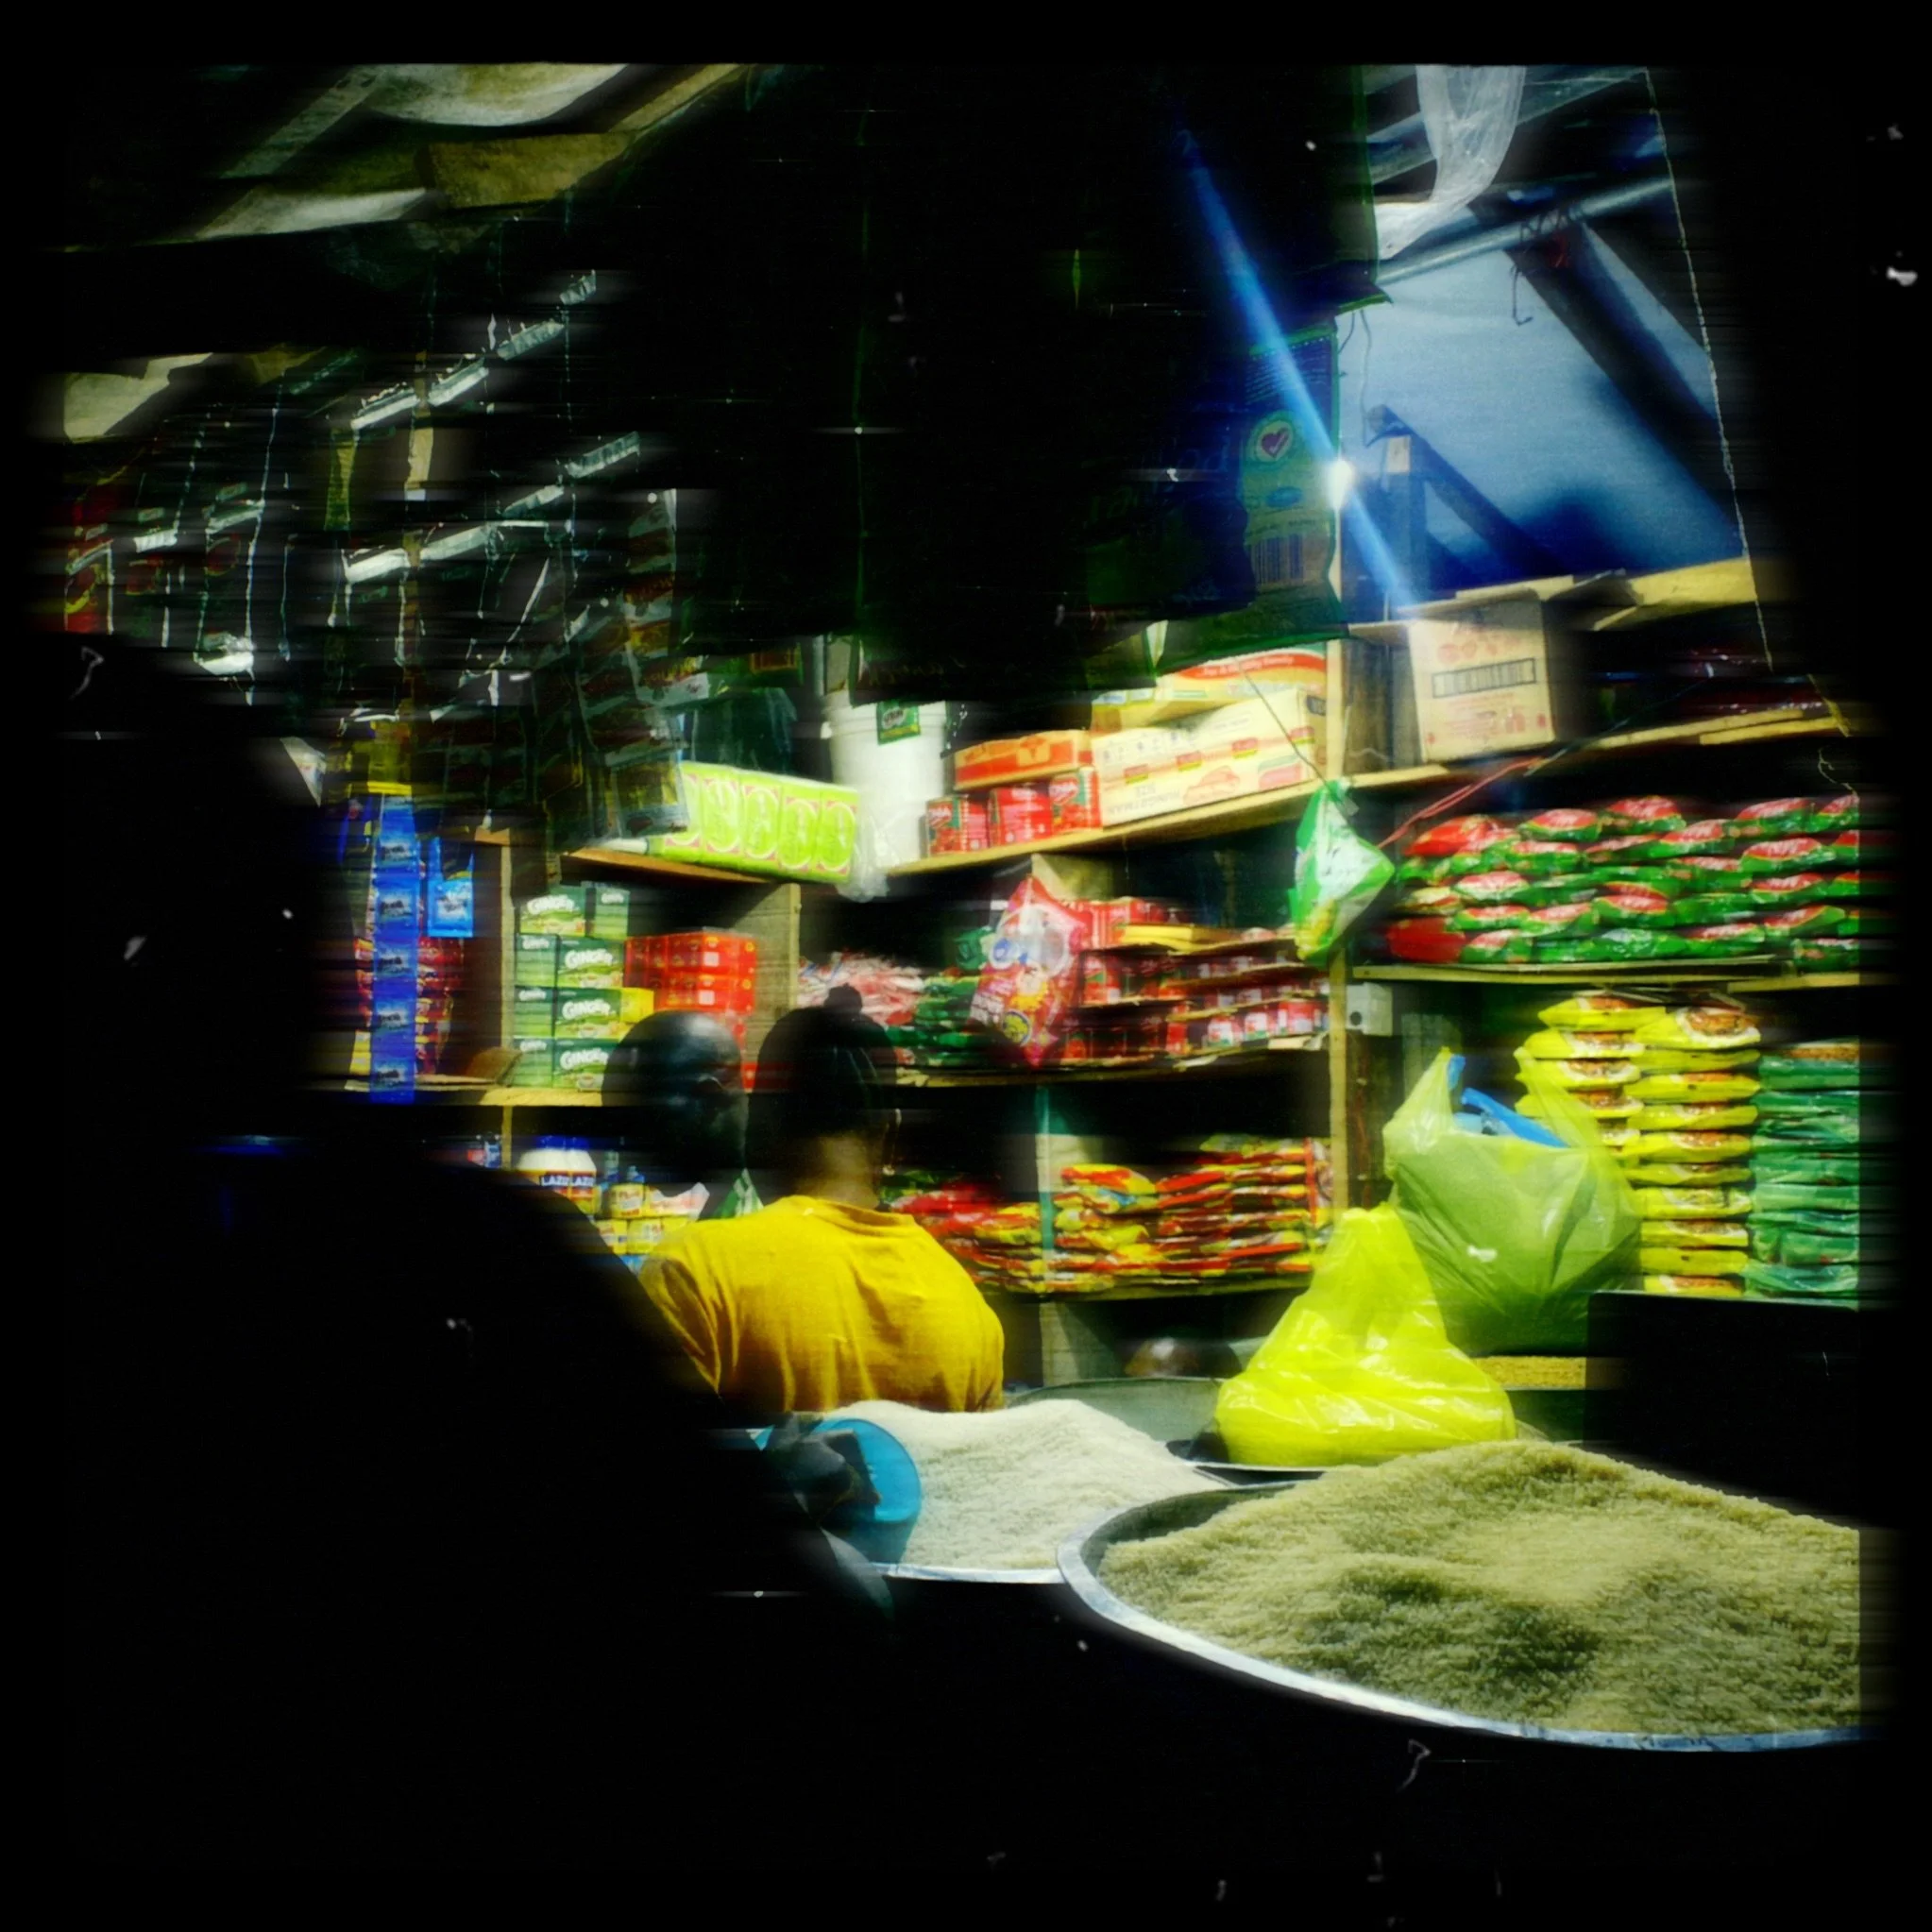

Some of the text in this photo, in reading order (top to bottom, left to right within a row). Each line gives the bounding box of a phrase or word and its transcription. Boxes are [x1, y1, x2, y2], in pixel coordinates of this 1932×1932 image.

[526, 894, 575, 915] GINGER
[565, 948, 614, 970] GINGER
[562, 999, 612, 1021] GINGER
